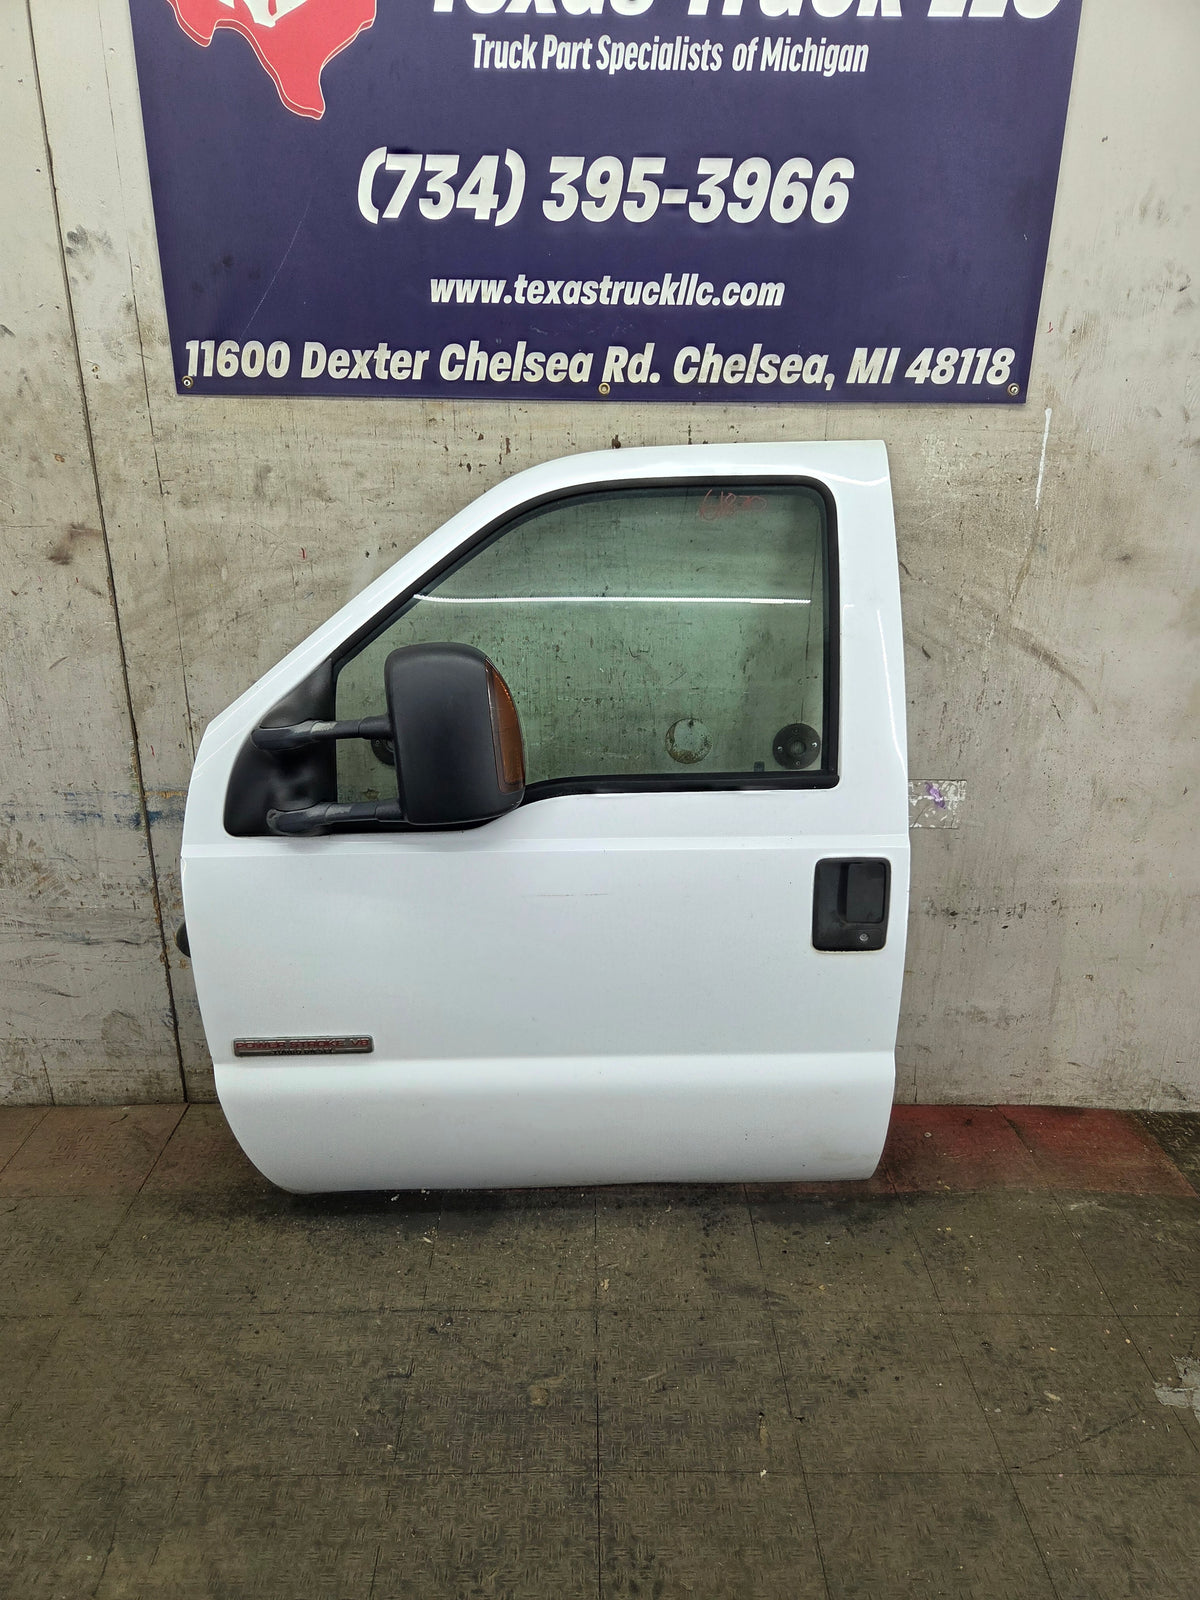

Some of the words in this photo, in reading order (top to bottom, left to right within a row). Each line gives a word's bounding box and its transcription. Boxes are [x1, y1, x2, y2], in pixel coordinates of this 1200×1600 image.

[472, 33, 538, 70] Truck
[541, 34, 593, 70] Part
[596, 34, 724, 76] Specialists
[731, 36, 760, 72] of
[759, 36, 870, 78] Michigan
[357, 146, 526, 227] (734)
[542, 155, 855, 224] 395-3966
[430, 273, 786, 307] www.texastruckllc.com
[184, 340, 291, 381] 11600
[300, 341, 430, 381] Dexter
[439, 340, 594, 383] Chelsea
[601, 342, 661, 384] Rd.
[673, 342, 835, 391] Chelsea,
[845, 347, 901, 384] MI
[904, 347, 1016, 386] 48118
[235, 1040, 286, 1050] POWER
